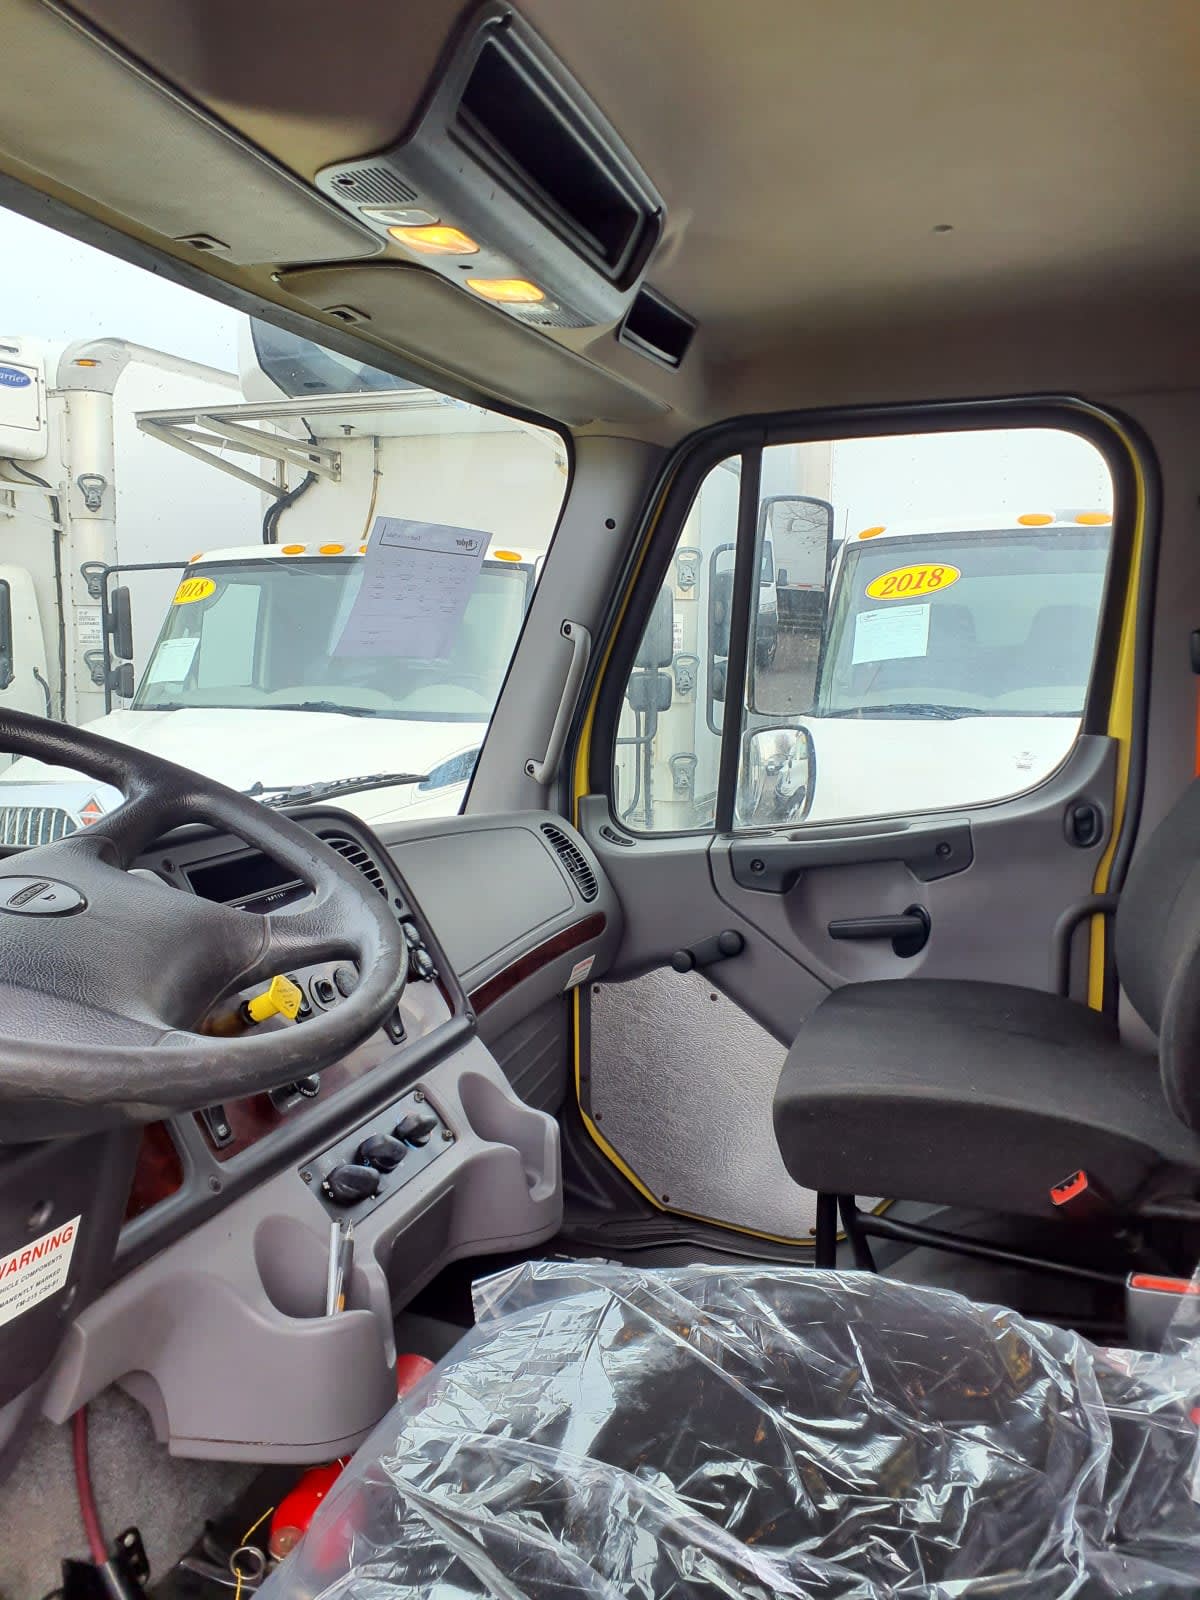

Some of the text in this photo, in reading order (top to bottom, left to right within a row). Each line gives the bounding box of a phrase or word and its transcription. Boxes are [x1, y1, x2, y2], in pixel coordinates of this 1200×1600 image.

[176, 581, 208, 601] 2018
[879, 567, 945, 597] 2018
[21, 1254, 63, 1283] COMPONENTS
[36, 1268, 61, 1287] MARKED
